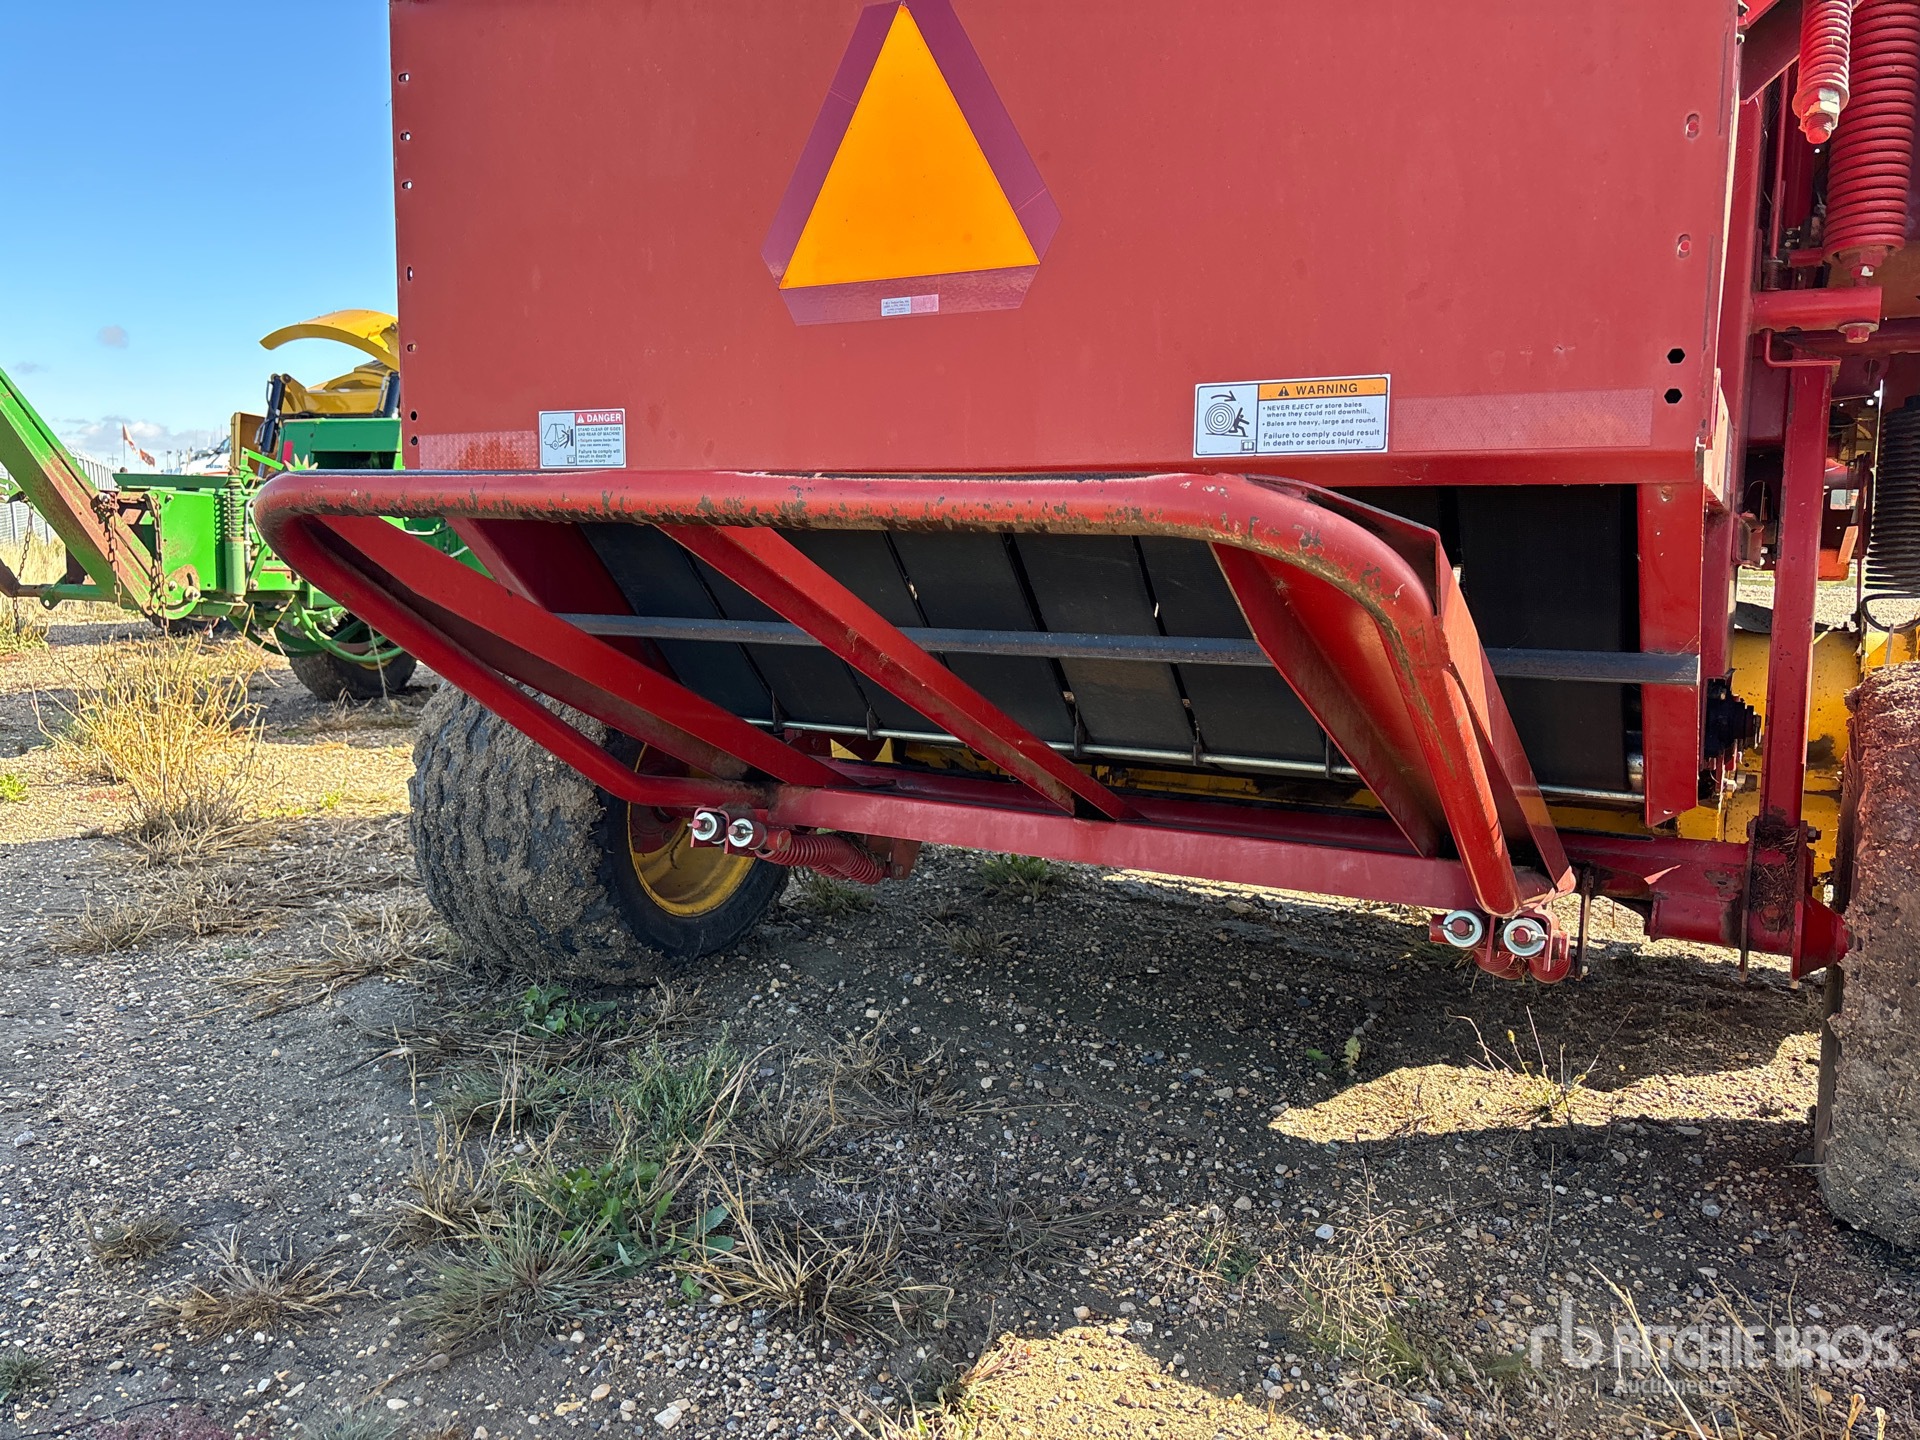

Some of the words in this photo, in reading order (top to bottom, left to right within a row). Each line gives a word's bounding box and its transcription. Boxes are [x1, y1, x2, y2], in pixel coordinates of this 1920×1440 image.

[1296, 383, 1358, 395] WARNING
[587, 413, 622, 423] DANGER
[1299, 419, 1320, 427] heavy,
[1302, 430, 1330, 439] comply
[1332, 429, 1355, 437] could
[1306, 438, 1336, 446] serious
[1337, 437, 1363, 446] injury.
